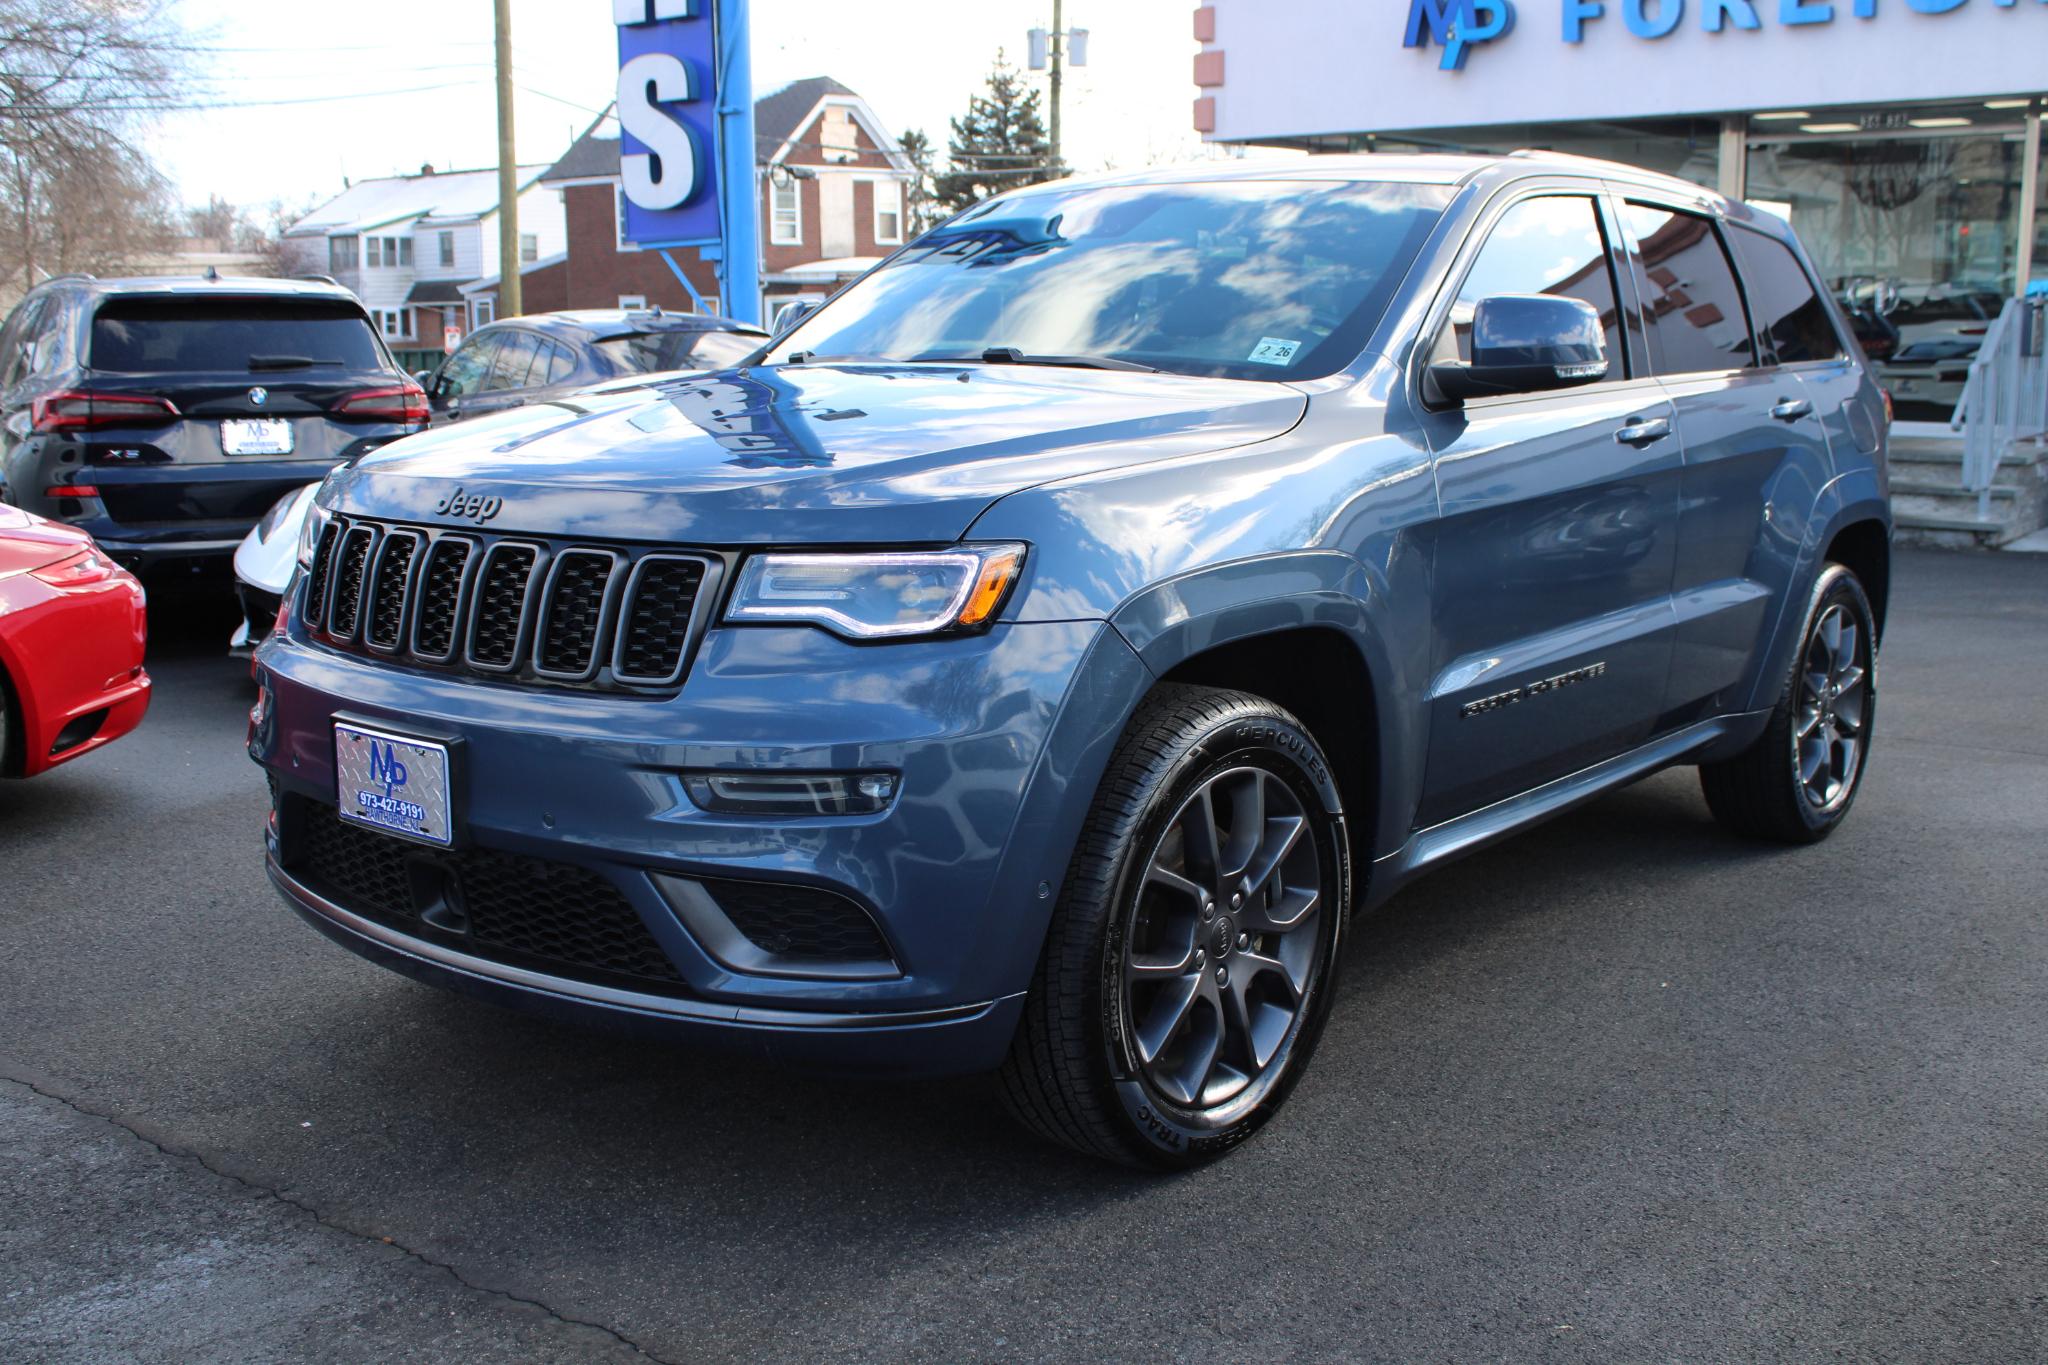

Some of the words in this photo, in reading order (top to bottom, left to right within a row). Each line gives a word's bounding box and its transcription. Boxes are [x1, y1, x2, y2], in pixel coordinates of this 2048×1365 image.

[1260, 346, 1271, 356] 2
[1275, 346, 1292, 357] 26
[435, 486, 503, 525] Jeep
[1236, 726, 1328, 785] HERCULES
[360, 792, 423, 820] 973-427-9191
[1136, 1104, 1181, 1148] TRAC
